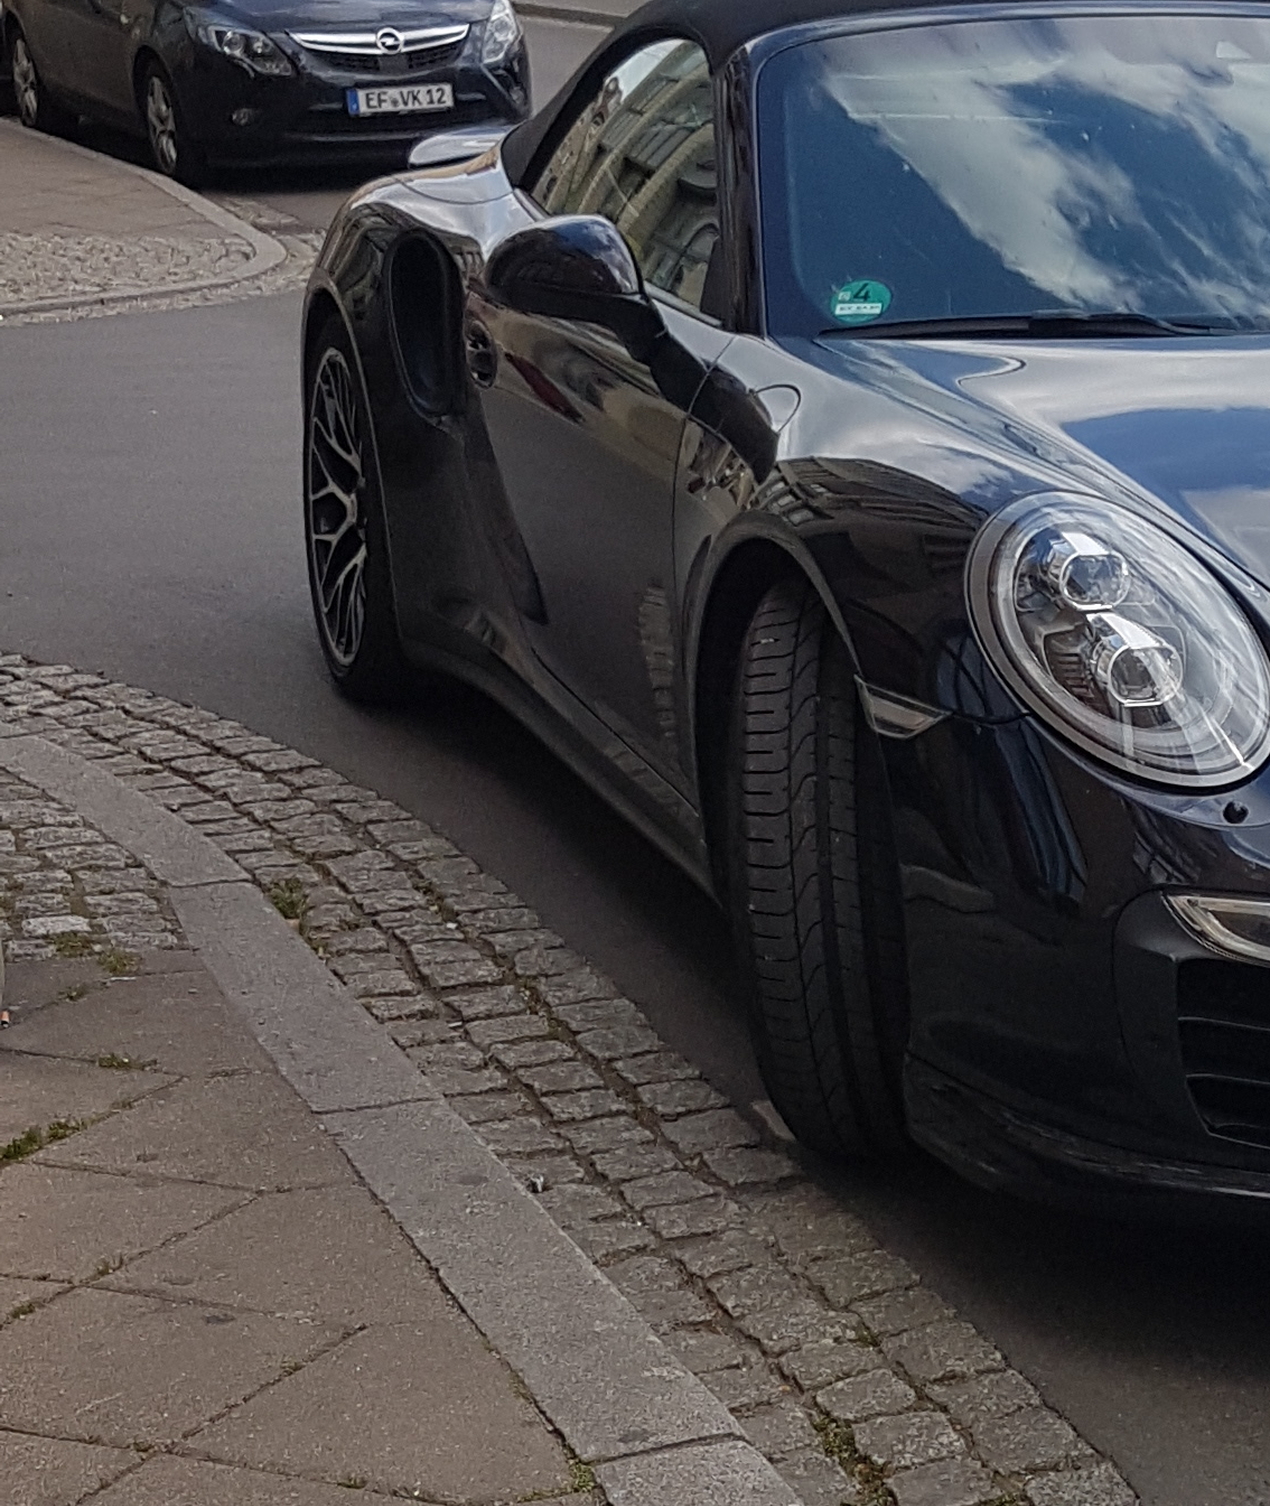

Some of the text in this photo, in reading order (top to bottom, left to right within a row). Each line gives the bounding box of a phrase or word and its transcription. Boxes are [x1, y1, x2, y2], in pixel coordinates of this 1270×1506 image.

[365, 87, 446, 109] EF VK 12
[852, 282, 872, 302] 4
